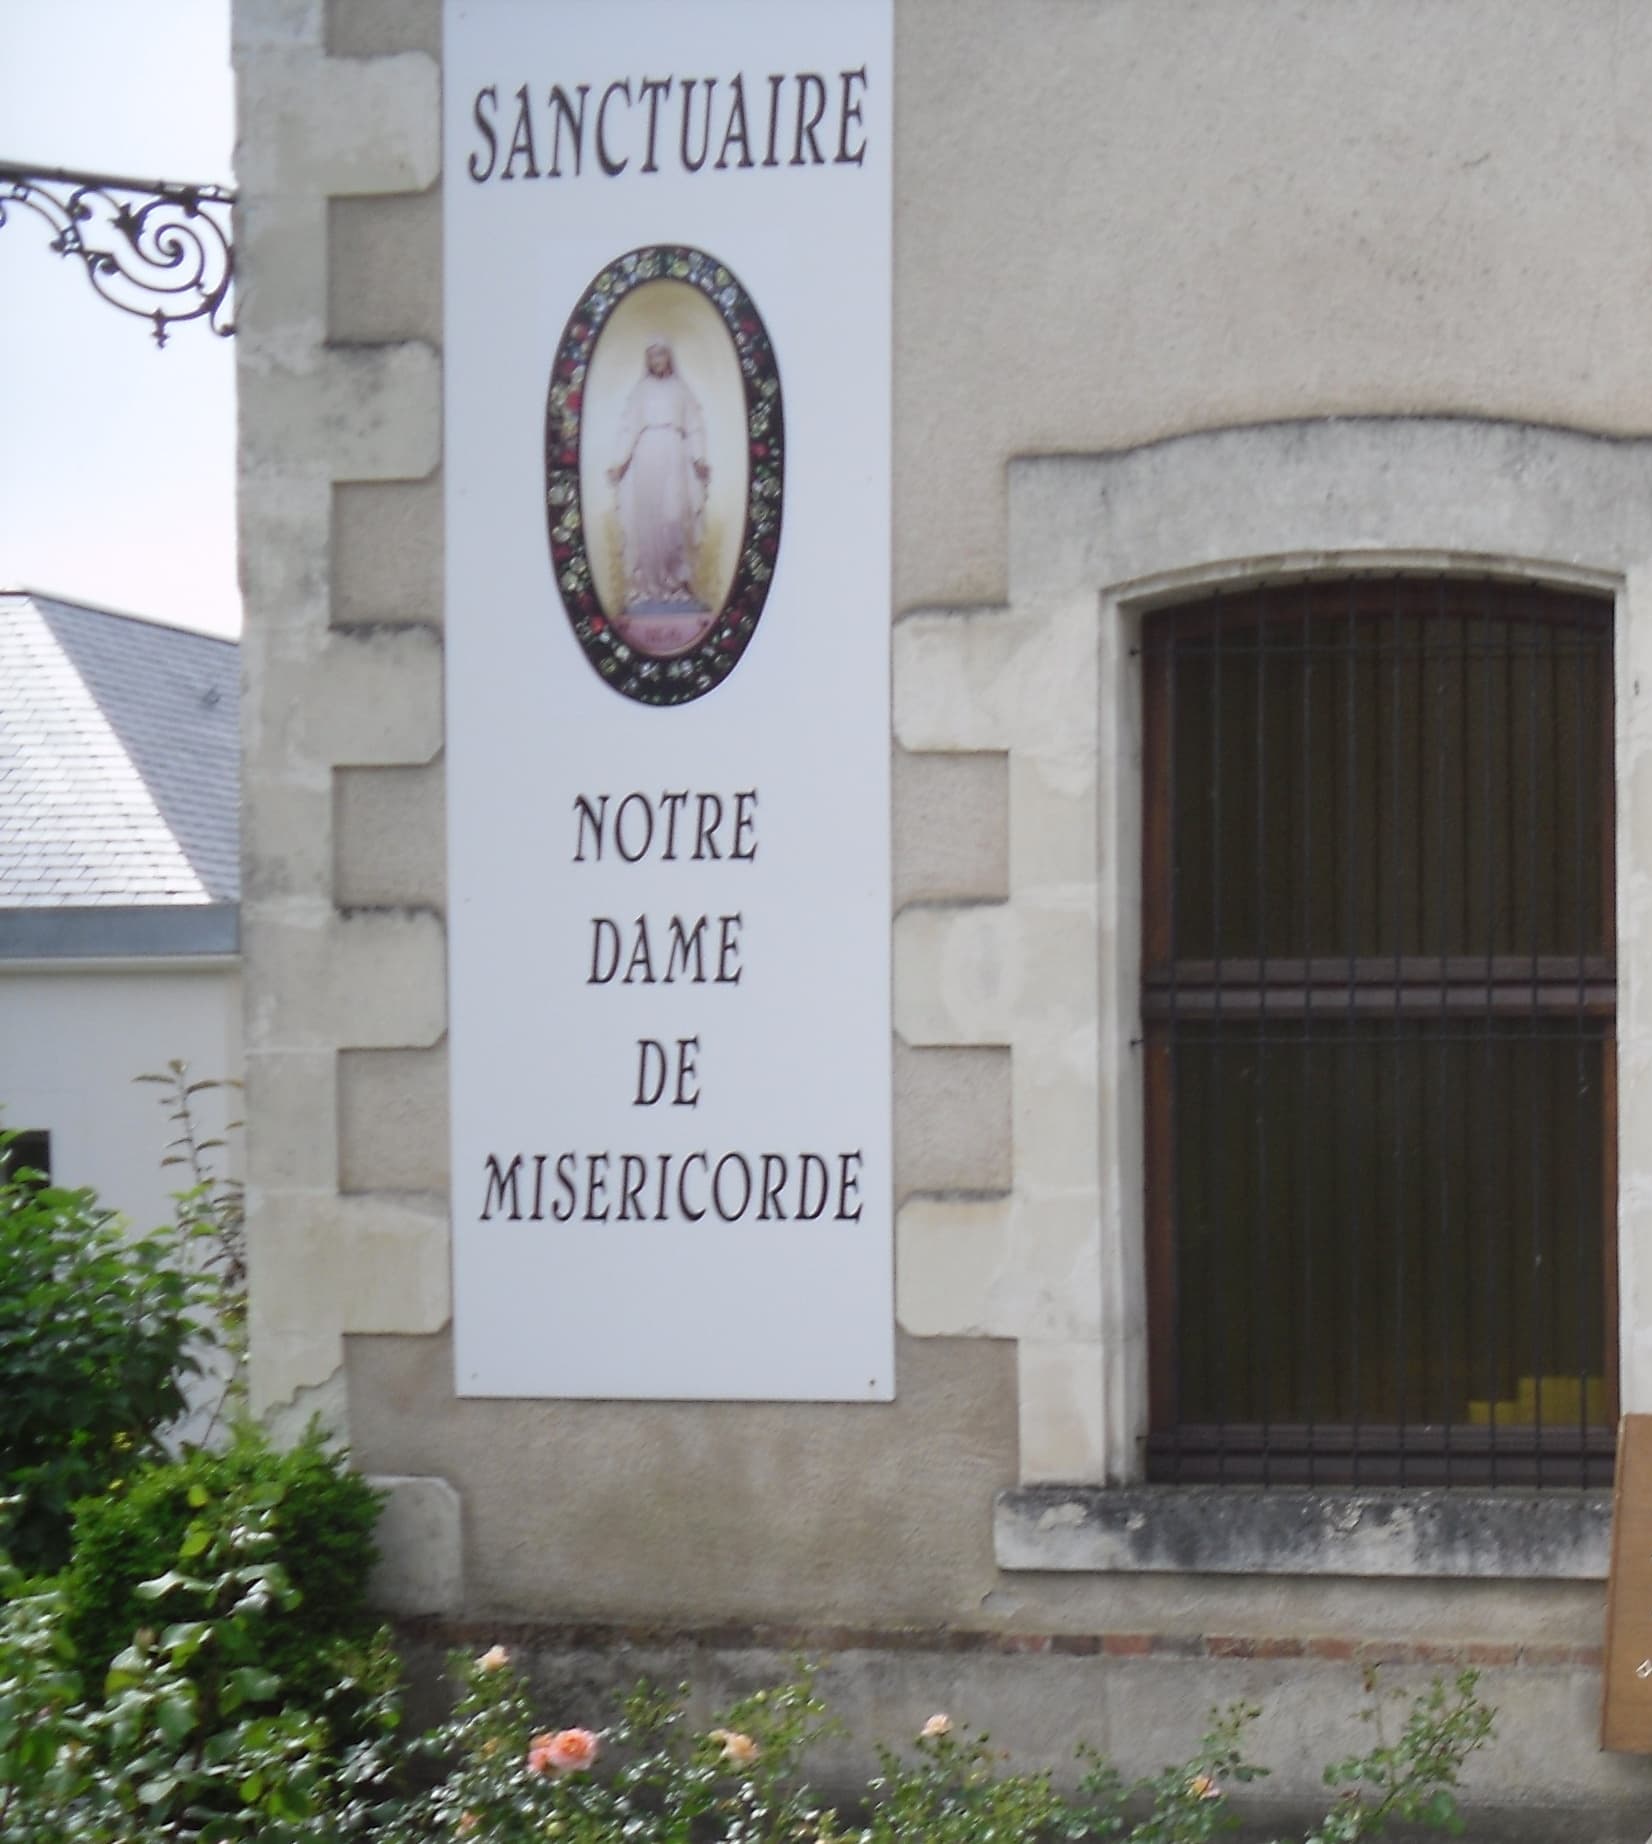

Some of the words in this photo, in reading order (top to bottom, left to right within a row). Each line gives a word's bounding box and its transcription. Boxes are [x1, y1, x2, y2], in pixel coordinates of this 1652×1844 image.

[468, 65, 869, 185] SANCTUAIRE
[573, 789, 758, 863] NOTRE
[587, 911, 744, 986] DAME
[632, 1034, 701, 1109] DE
[479, 1150, 864, 1225] MISERICORDE
